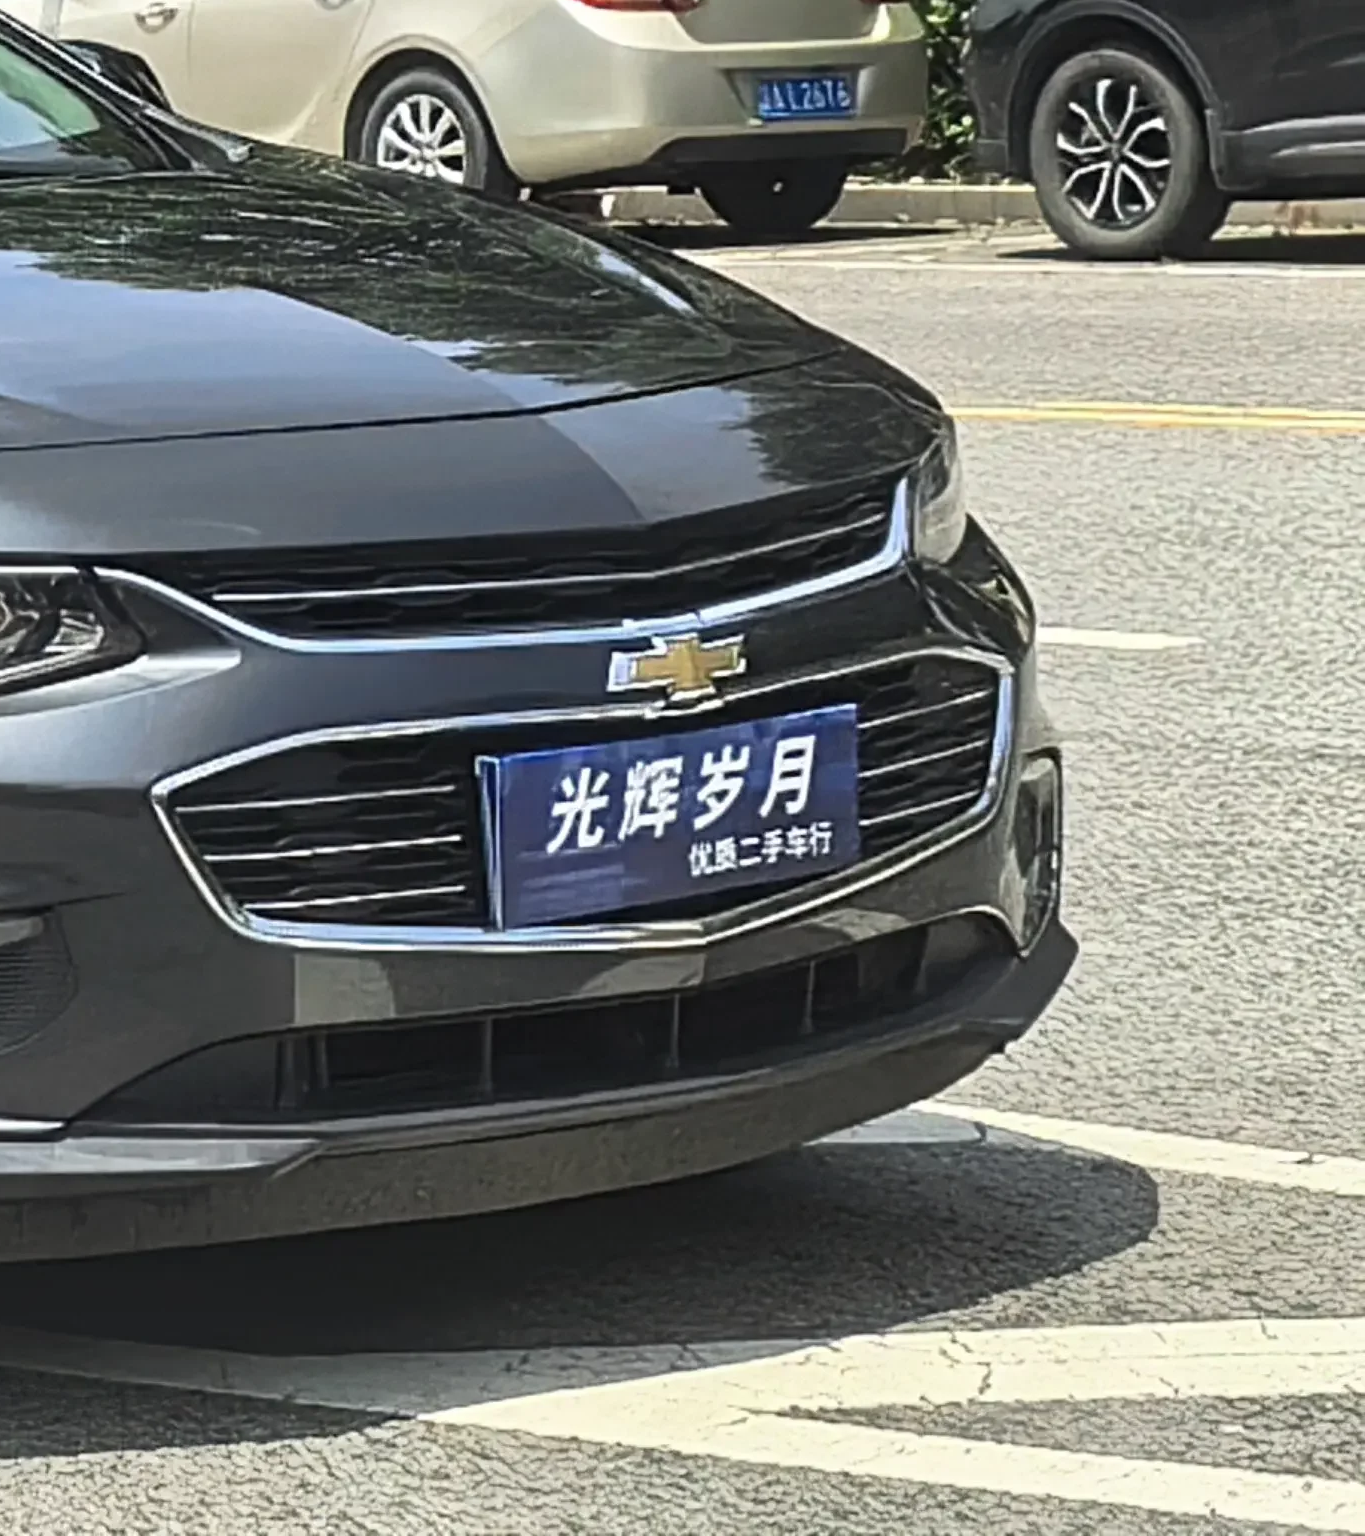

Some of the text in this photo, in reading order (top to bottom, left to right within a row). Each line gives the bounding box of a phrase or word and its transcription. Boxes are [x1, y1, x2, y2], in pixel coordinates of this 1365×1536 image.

[546, 735, 816, 855] 光辉岁月
[688, 822, 833, 878] 优质二手车行
